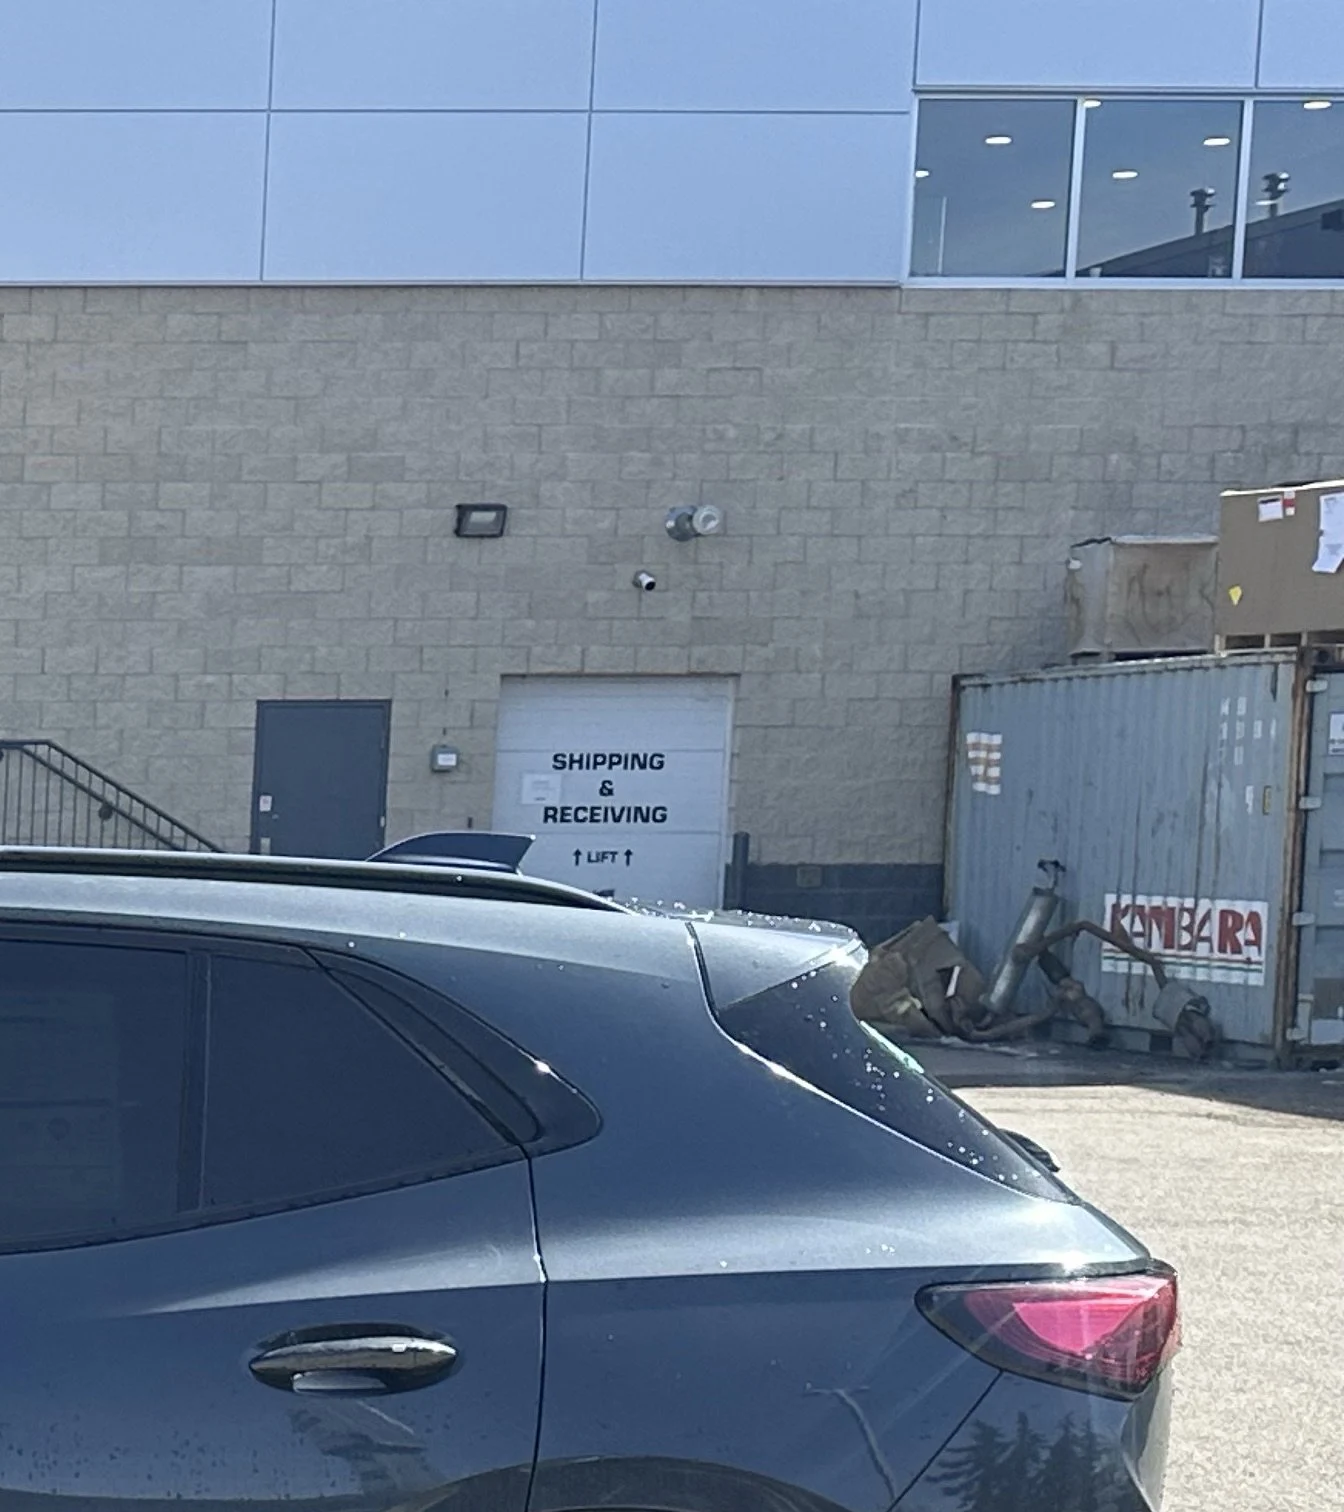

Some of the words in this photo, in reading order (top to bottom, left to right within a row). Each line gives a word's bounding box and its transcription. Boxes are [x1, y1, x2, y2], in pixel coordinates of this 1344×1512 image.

[552, 752, 666, 771] SHIPPING
[598, 780, 615, 797] &
[542, 806, 668, 824] RECEIVING
[586, 851, 619, 864] LIFT
